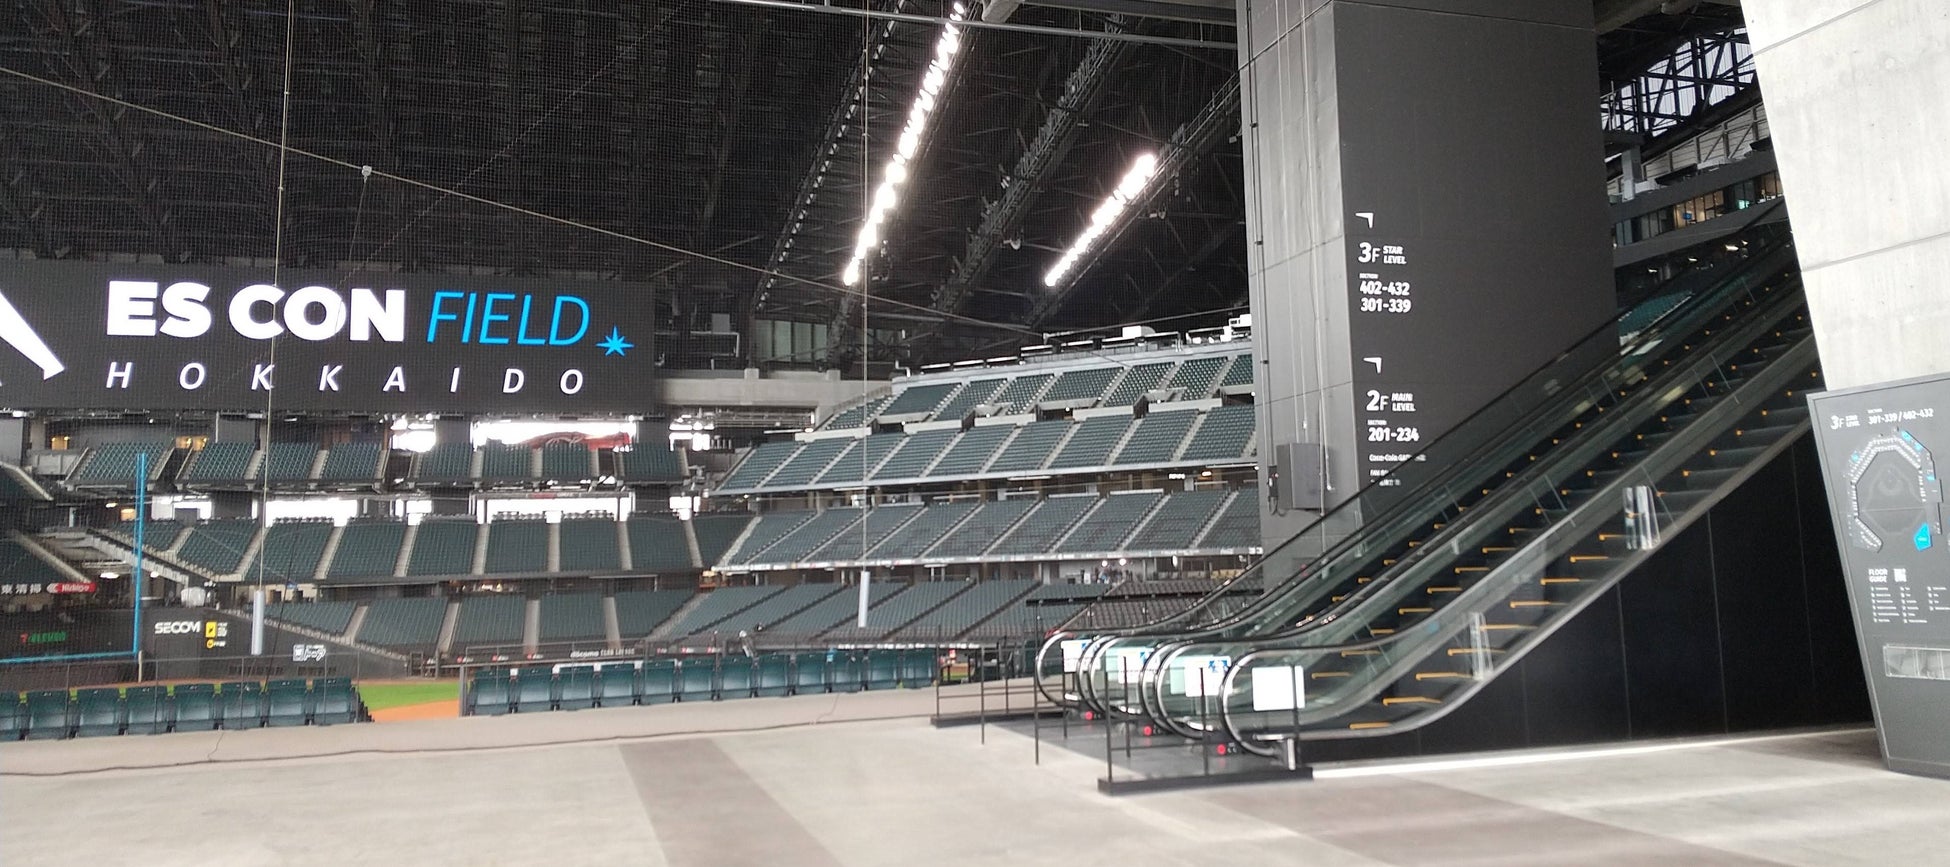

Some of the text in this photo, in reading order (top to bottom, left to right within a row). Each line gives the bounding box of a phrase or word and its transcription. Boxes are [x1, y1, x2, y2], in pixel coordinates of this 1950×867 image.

[1358, 242, 1403, 262] 3F STAR
[1384, 255, 1406, 264] LEVEL
[1360, 281, 1410, 295] 402-432
[1361, 298, 1411, 312] 301-339
[107, 281, 588, 344] ES CON FIELD
[107, 362, 582, 394] HOKKAIDO
[1367, 390, 1413, 411] 2F MAIN
[1392, 403, 1415, 411] LEVEL
[1830, 415, 1844, 430] 3F
[1368, 427, 1419, 441] 201-234
[155, 621, 201, 634] SECOM
